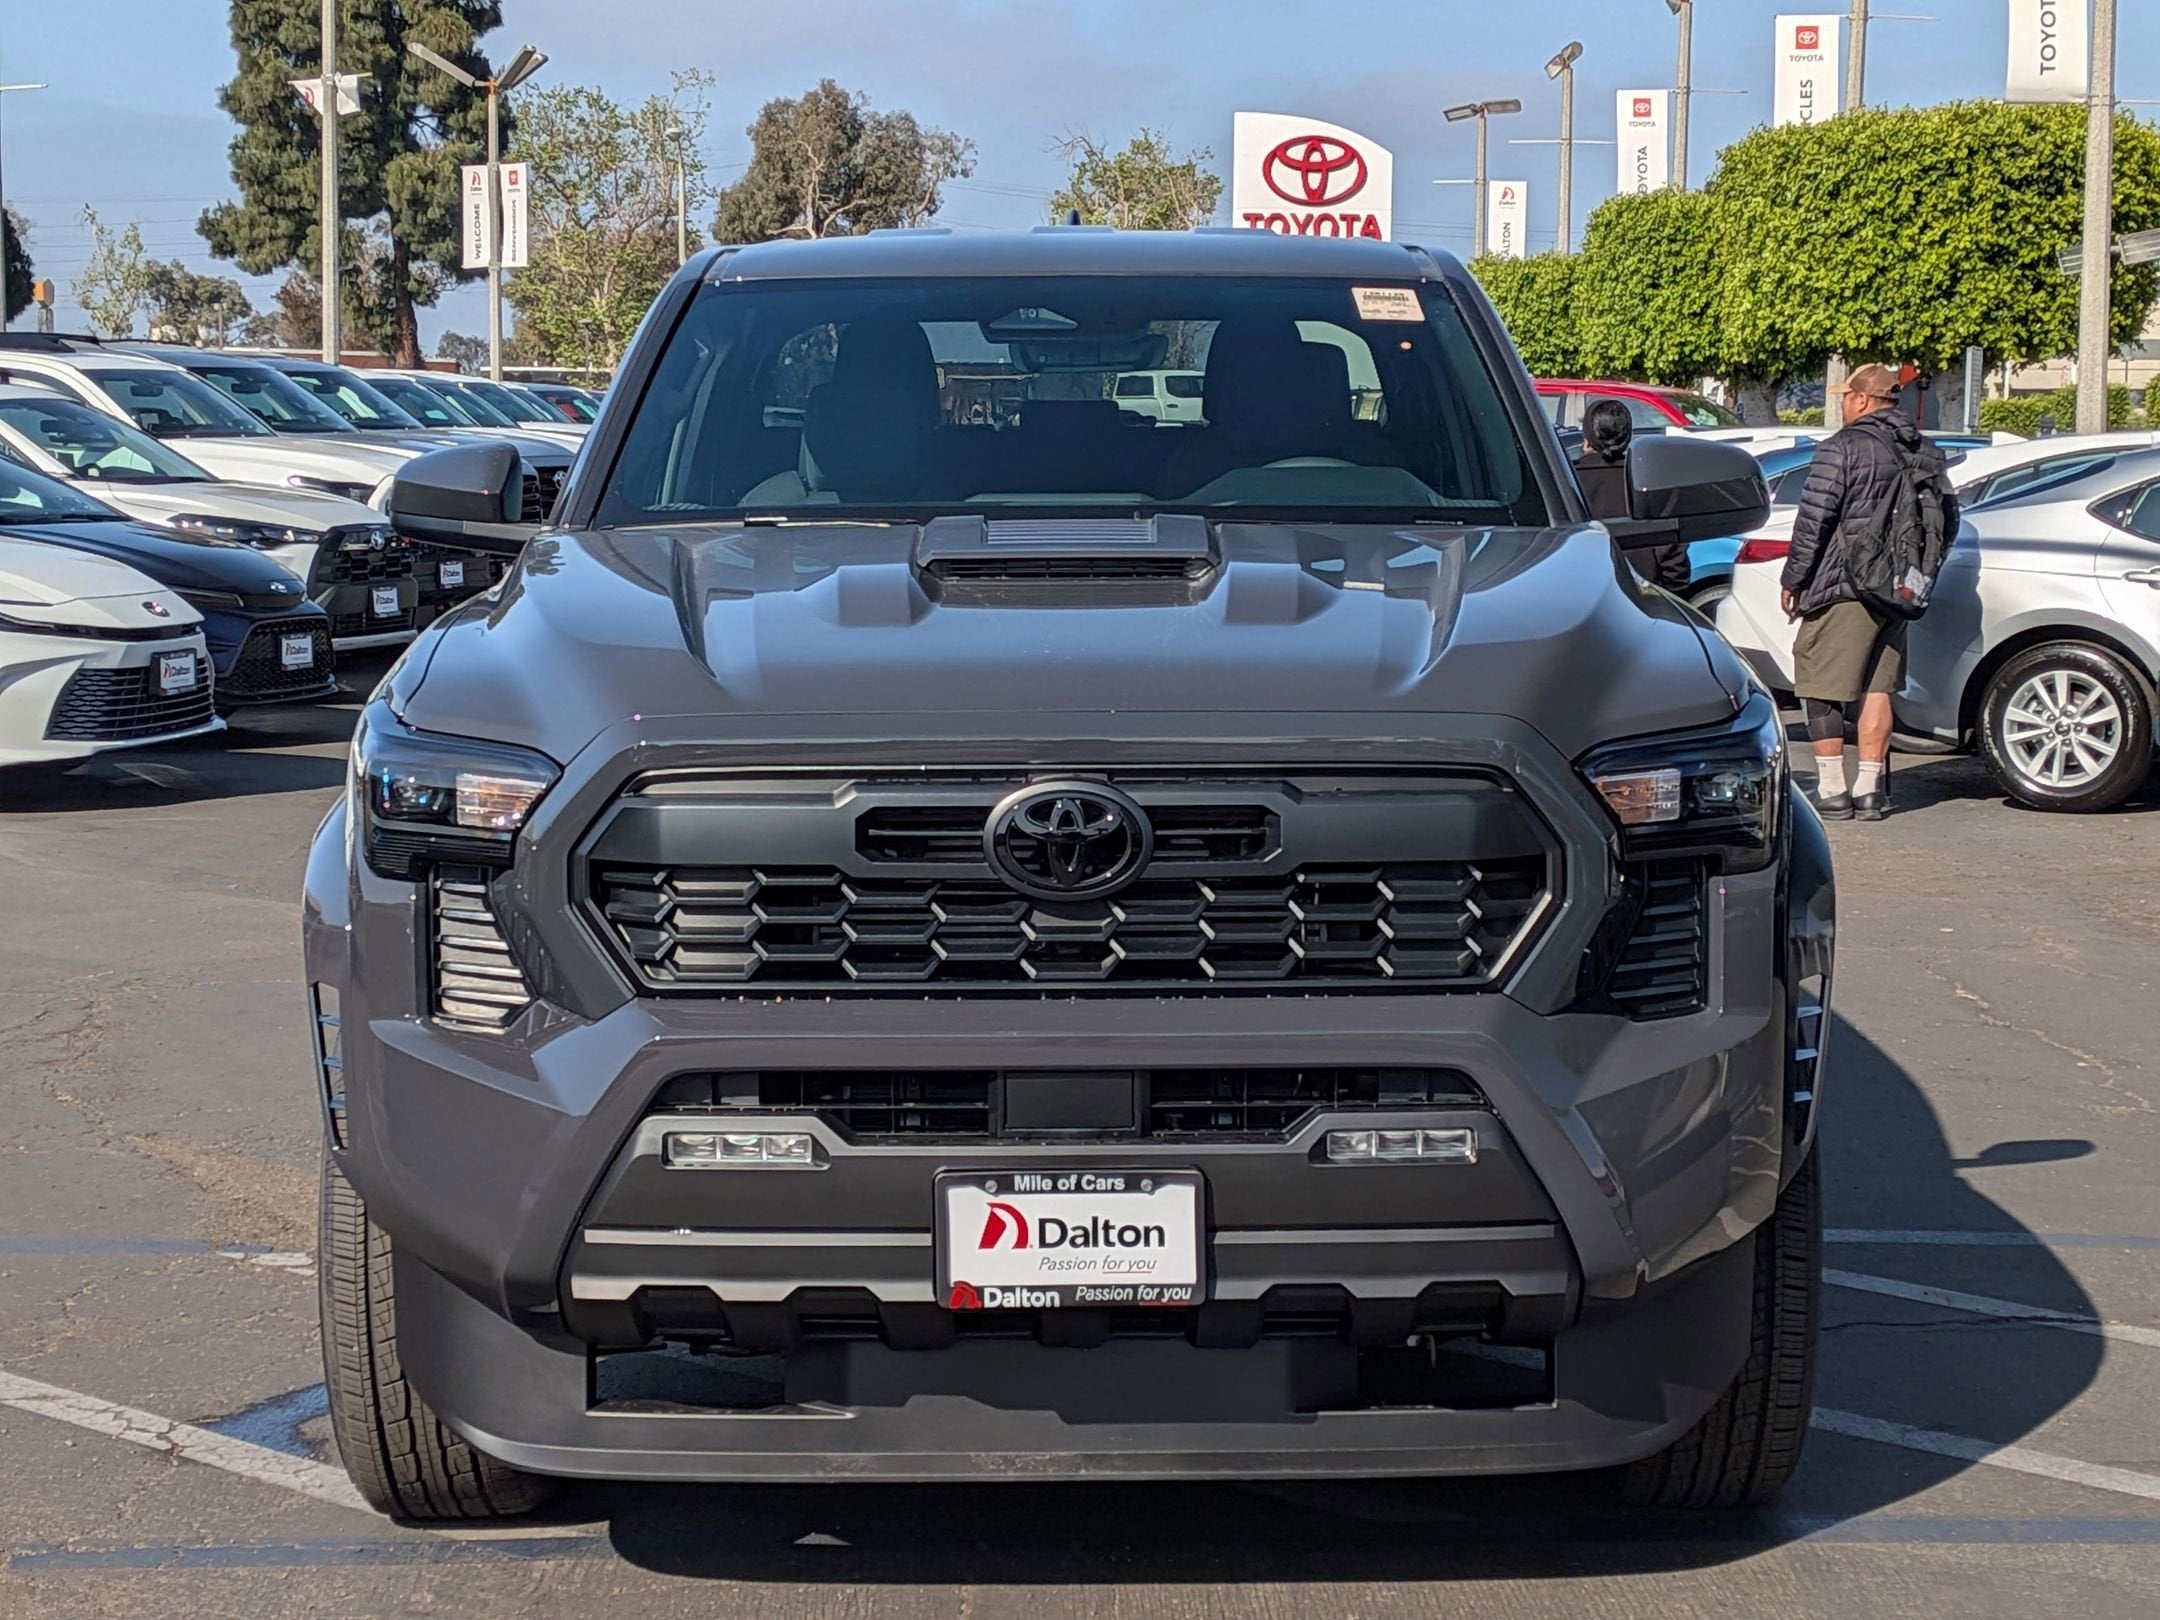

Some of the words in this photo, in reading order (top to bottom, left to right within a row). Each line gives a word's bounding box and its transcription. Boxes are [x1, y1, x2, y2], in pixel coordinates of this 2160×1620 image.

[1789, 54, 1824, 62] TOYOTA
[474, 203, 482, 260] WELCOME
[1242, 213, 1382, 241] TOYOTA
[1014, 1175, 1053, 1191] Mile
[1057, 1175, 1077, 1191] of
[1081, 1174, 1125, 1191] Cars
[1038, 1216, 1166, 1249] Dalton
[1039, 1257, 1097, 1271] Passion
[1101, 1255, 1125, 1271] for
[1128, 1259, 1158, 1272] you
[983, 1287, 1061, 1309] Dalton
[1076, 1286, 1134, 1302] Passion
[1137, 1285, 1161, 1301] for
[1161, 1287, 1192, 1303] you
